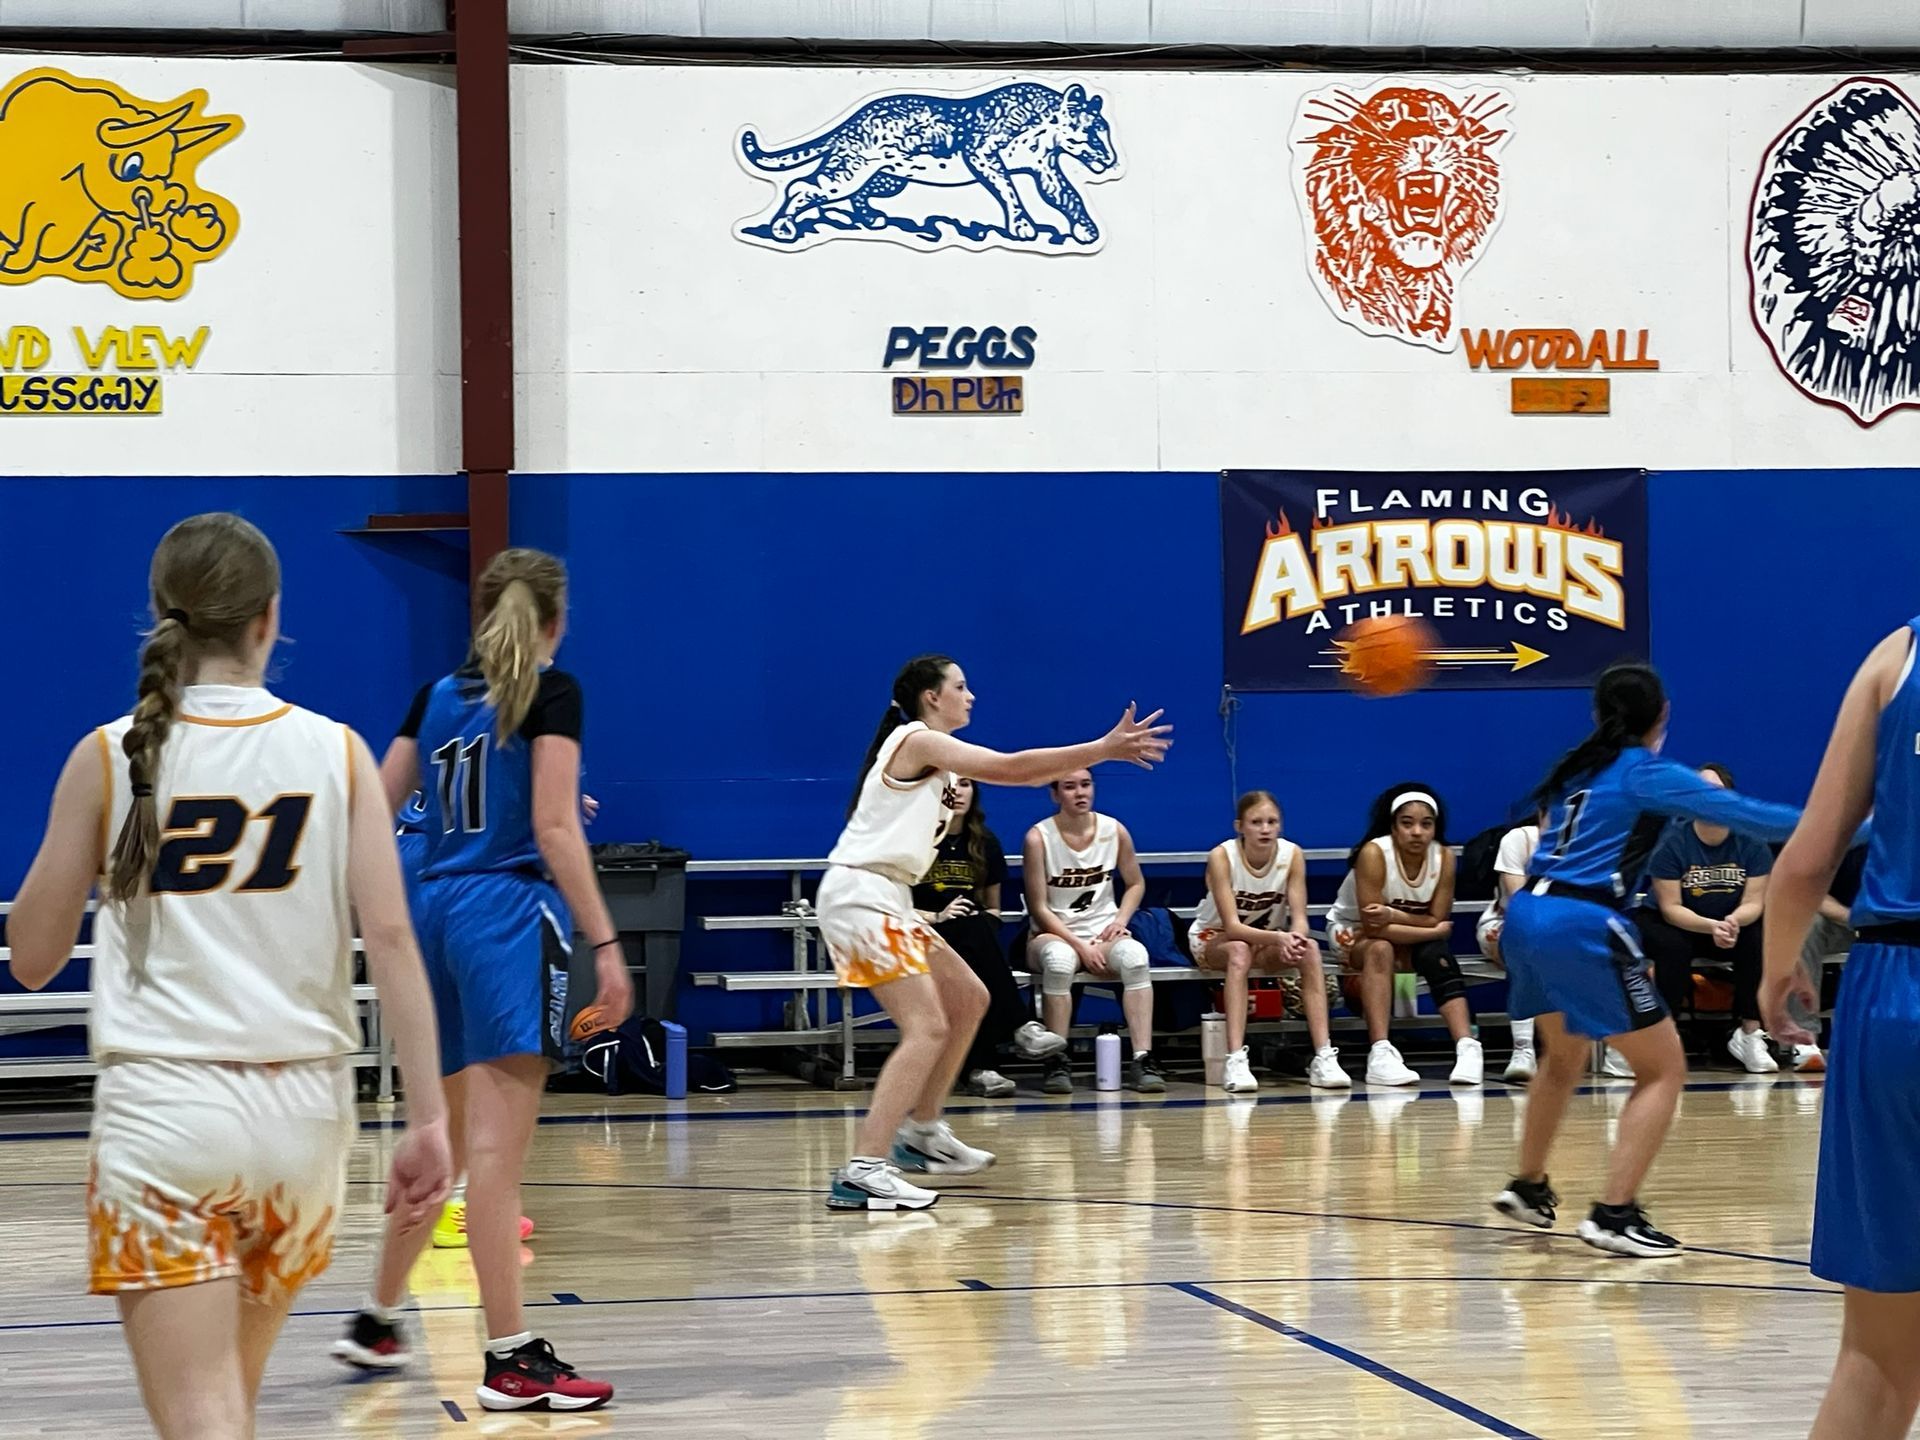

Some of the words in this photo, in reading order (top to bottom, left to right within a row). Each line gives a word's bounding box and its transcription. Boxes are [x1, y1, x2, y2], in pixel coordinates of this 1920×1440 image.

[72, 325, 210, 369] VIEW
[882, 325, 1038, 369] PEGGS
[1460, 328, 1660, 370] WOODALL
[1315, 487, 1551, 519] FLAMING
[1240, 517, 1627, 636] ARROWS
[1305, 597, 1570, 635] ATHLETICS
[430, 732, 491, 835] 11
[151, 792, 315, 896] 21
[1069, 889, 1097, 914] 4
